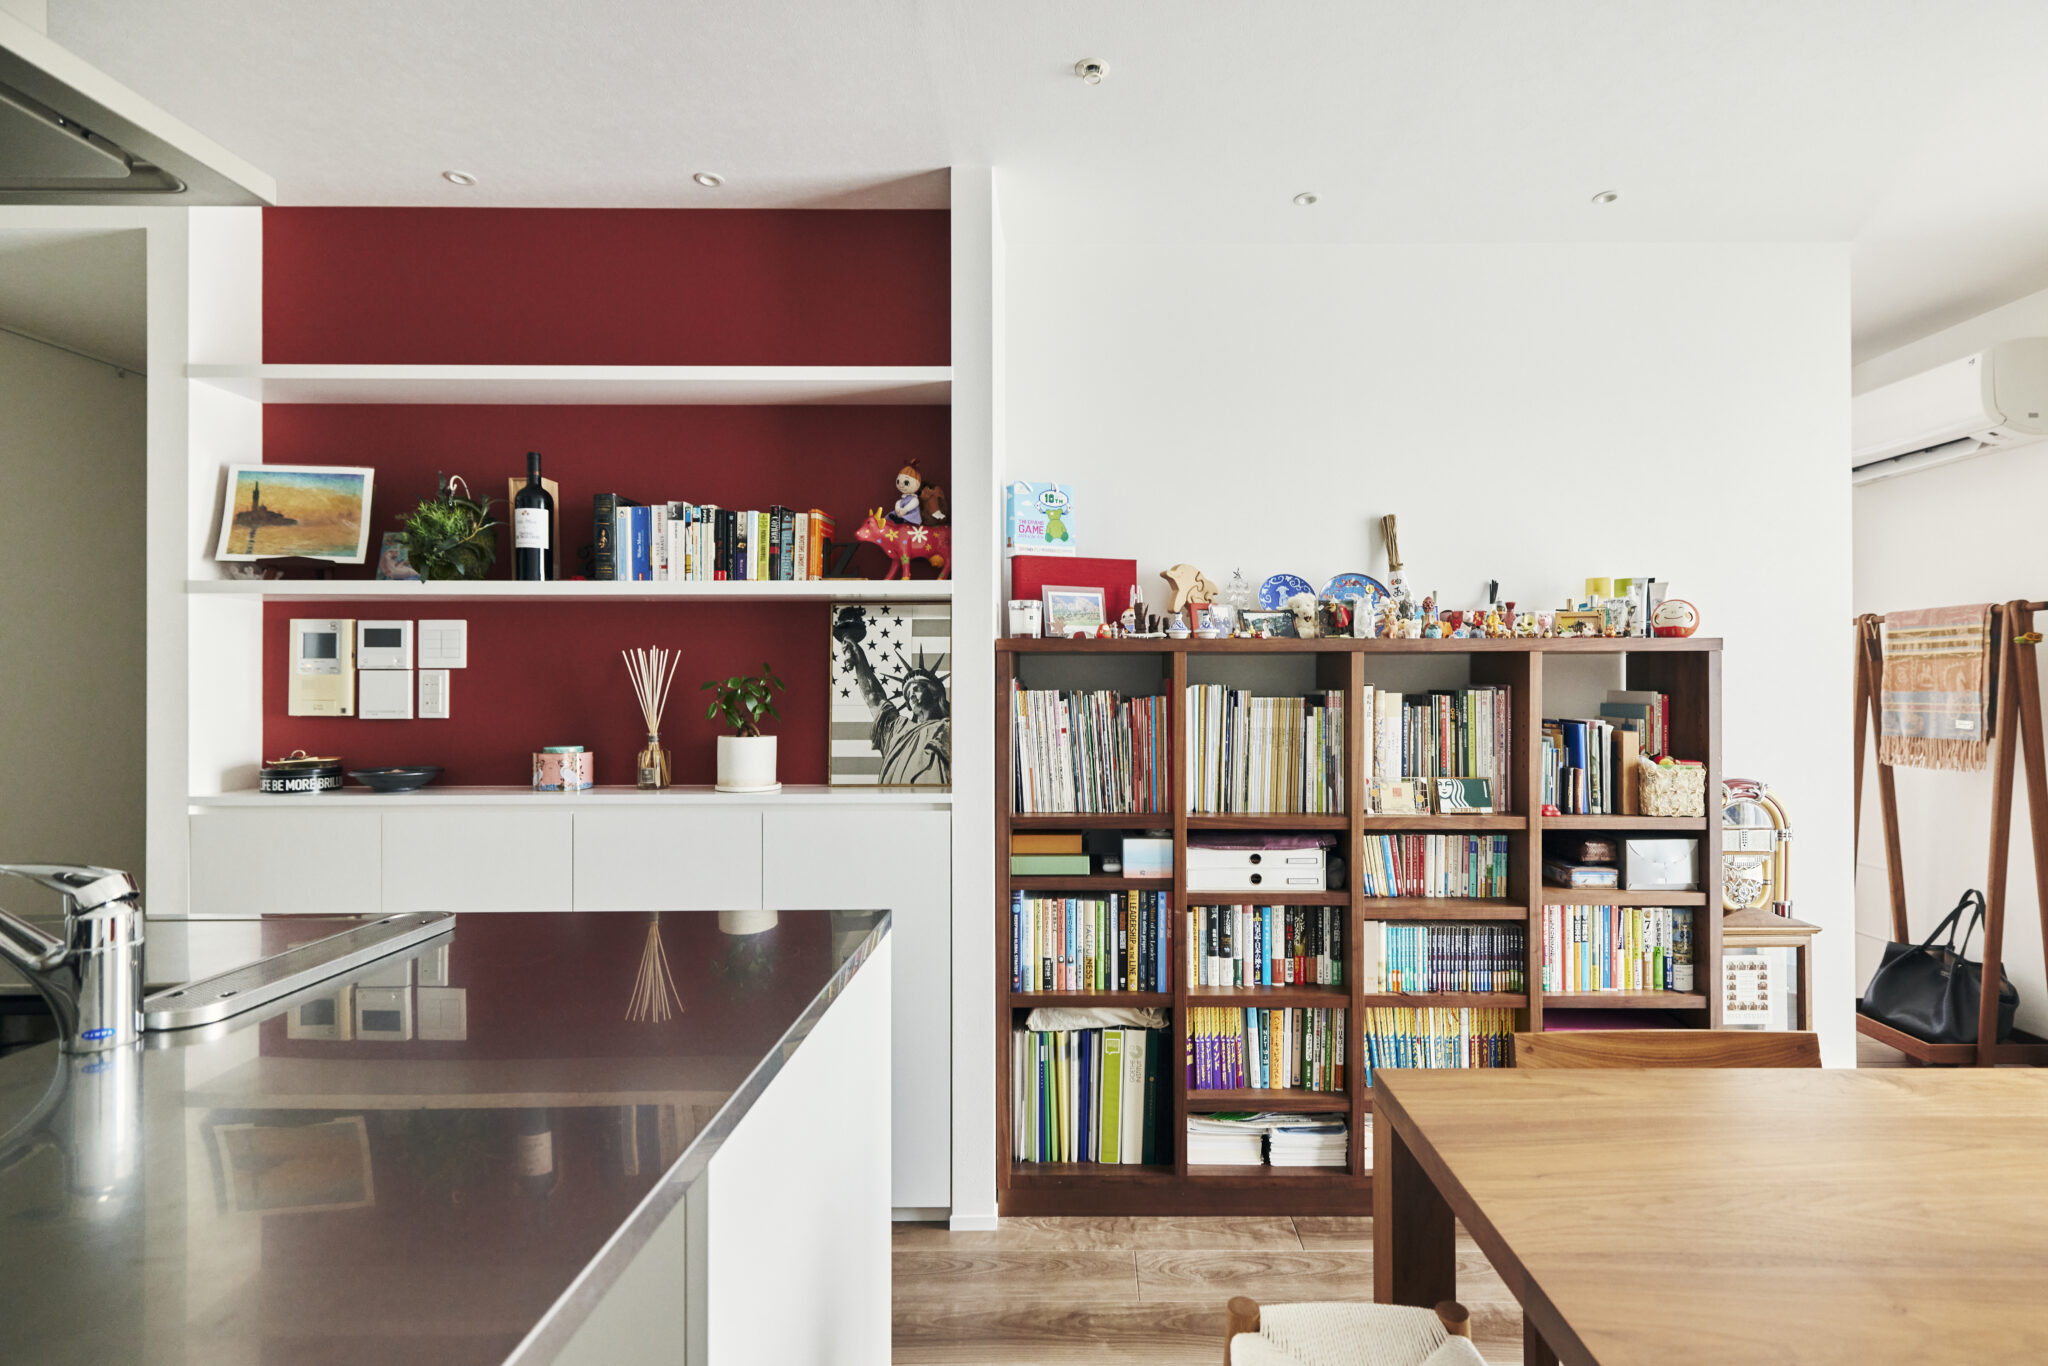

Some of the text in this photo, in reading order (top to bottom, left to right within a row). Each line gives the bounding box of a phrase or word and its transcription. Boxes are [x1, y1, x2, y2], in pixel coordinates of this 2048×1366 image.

[1018, 524, 1044, 535] GAME
[272, 780, 284, 791] BE
[285, 779, 316, 791] MORE
[1129, 902, 1137, 945] LEADERSHIP
[1085, 924, 1094, 979] FACTFULNESS
[1128, 960, 1136, 976] LINE
